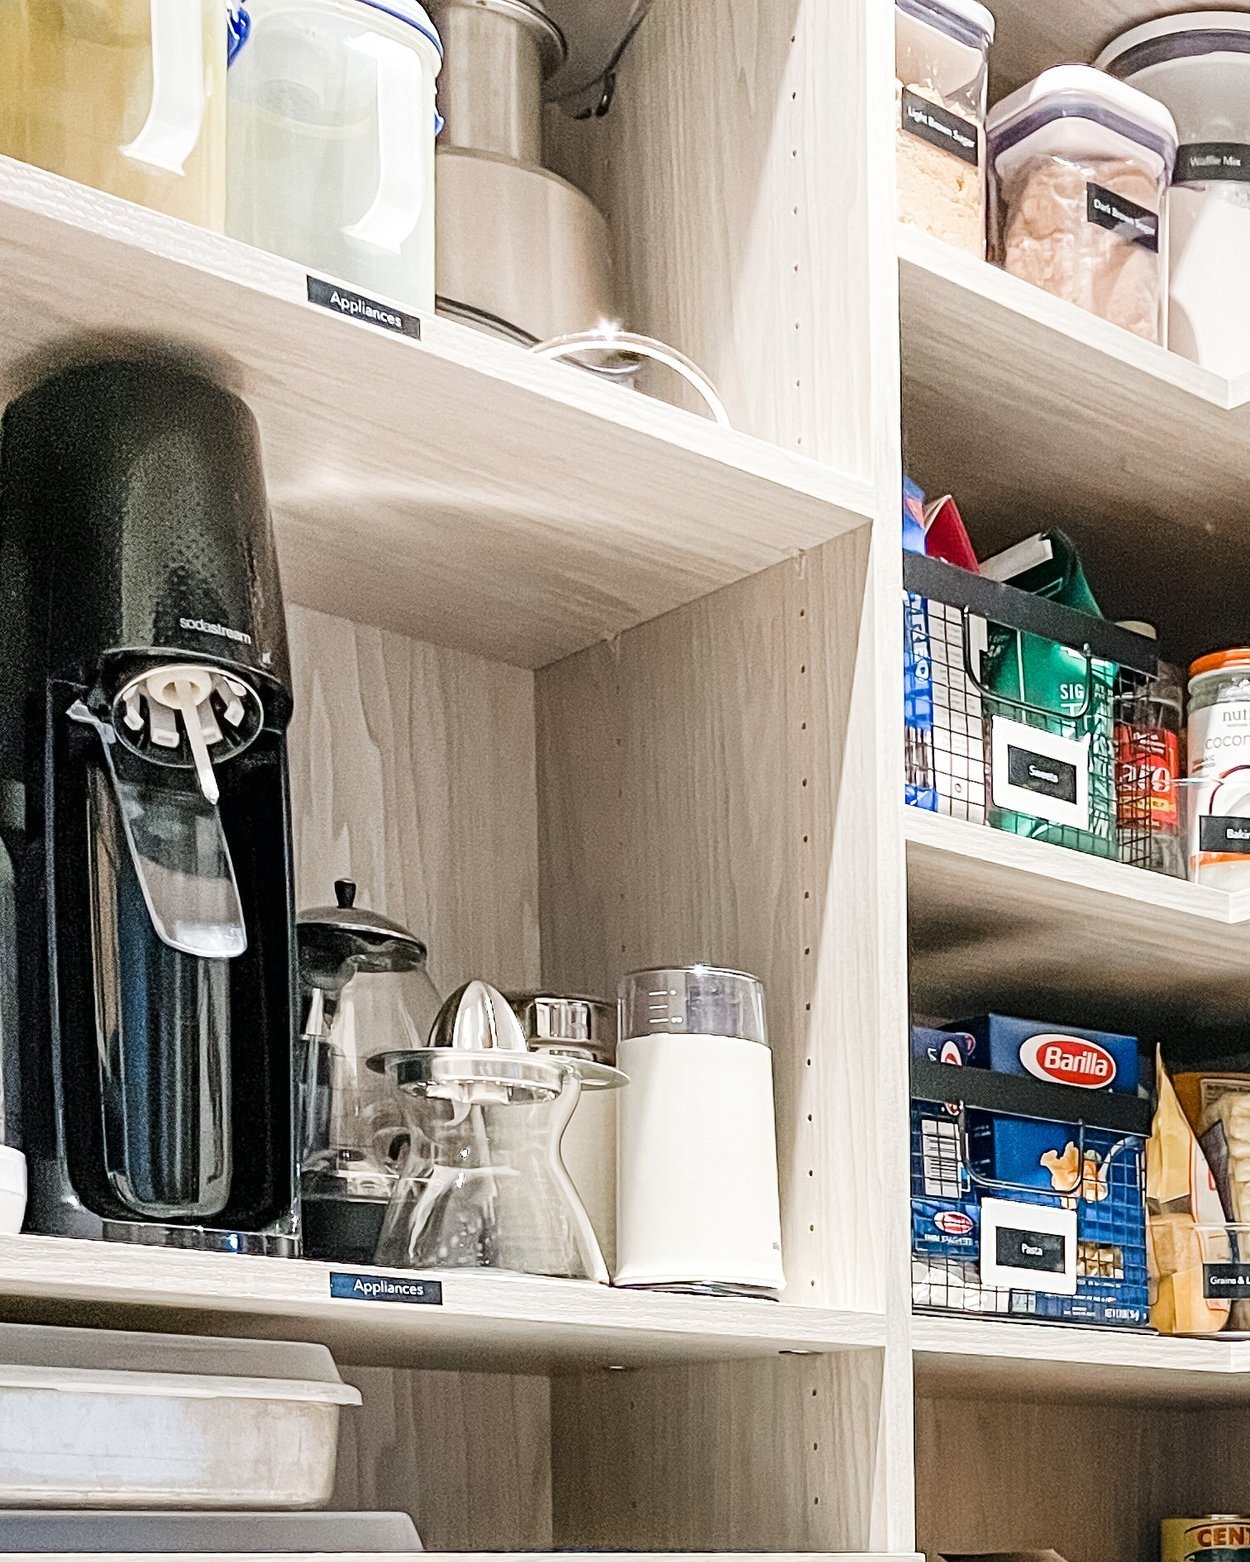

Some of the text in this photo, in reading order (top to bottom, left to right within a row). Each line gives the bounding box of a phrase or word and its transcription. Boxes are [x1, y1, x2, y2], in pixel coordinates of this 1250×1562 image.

[329, 290, 403, 330] Appliances
[178, 616, 252, 645] sodastream
[1044, 1046, 1109, 1077] Barilla
[1021, 1242, 1044, 1256] Pasta
[353, 1278, 425, 1298] Appliances
[1209, 1275, 1237, 1286] Grains
[1237, 1275, 1245, 1285] &
